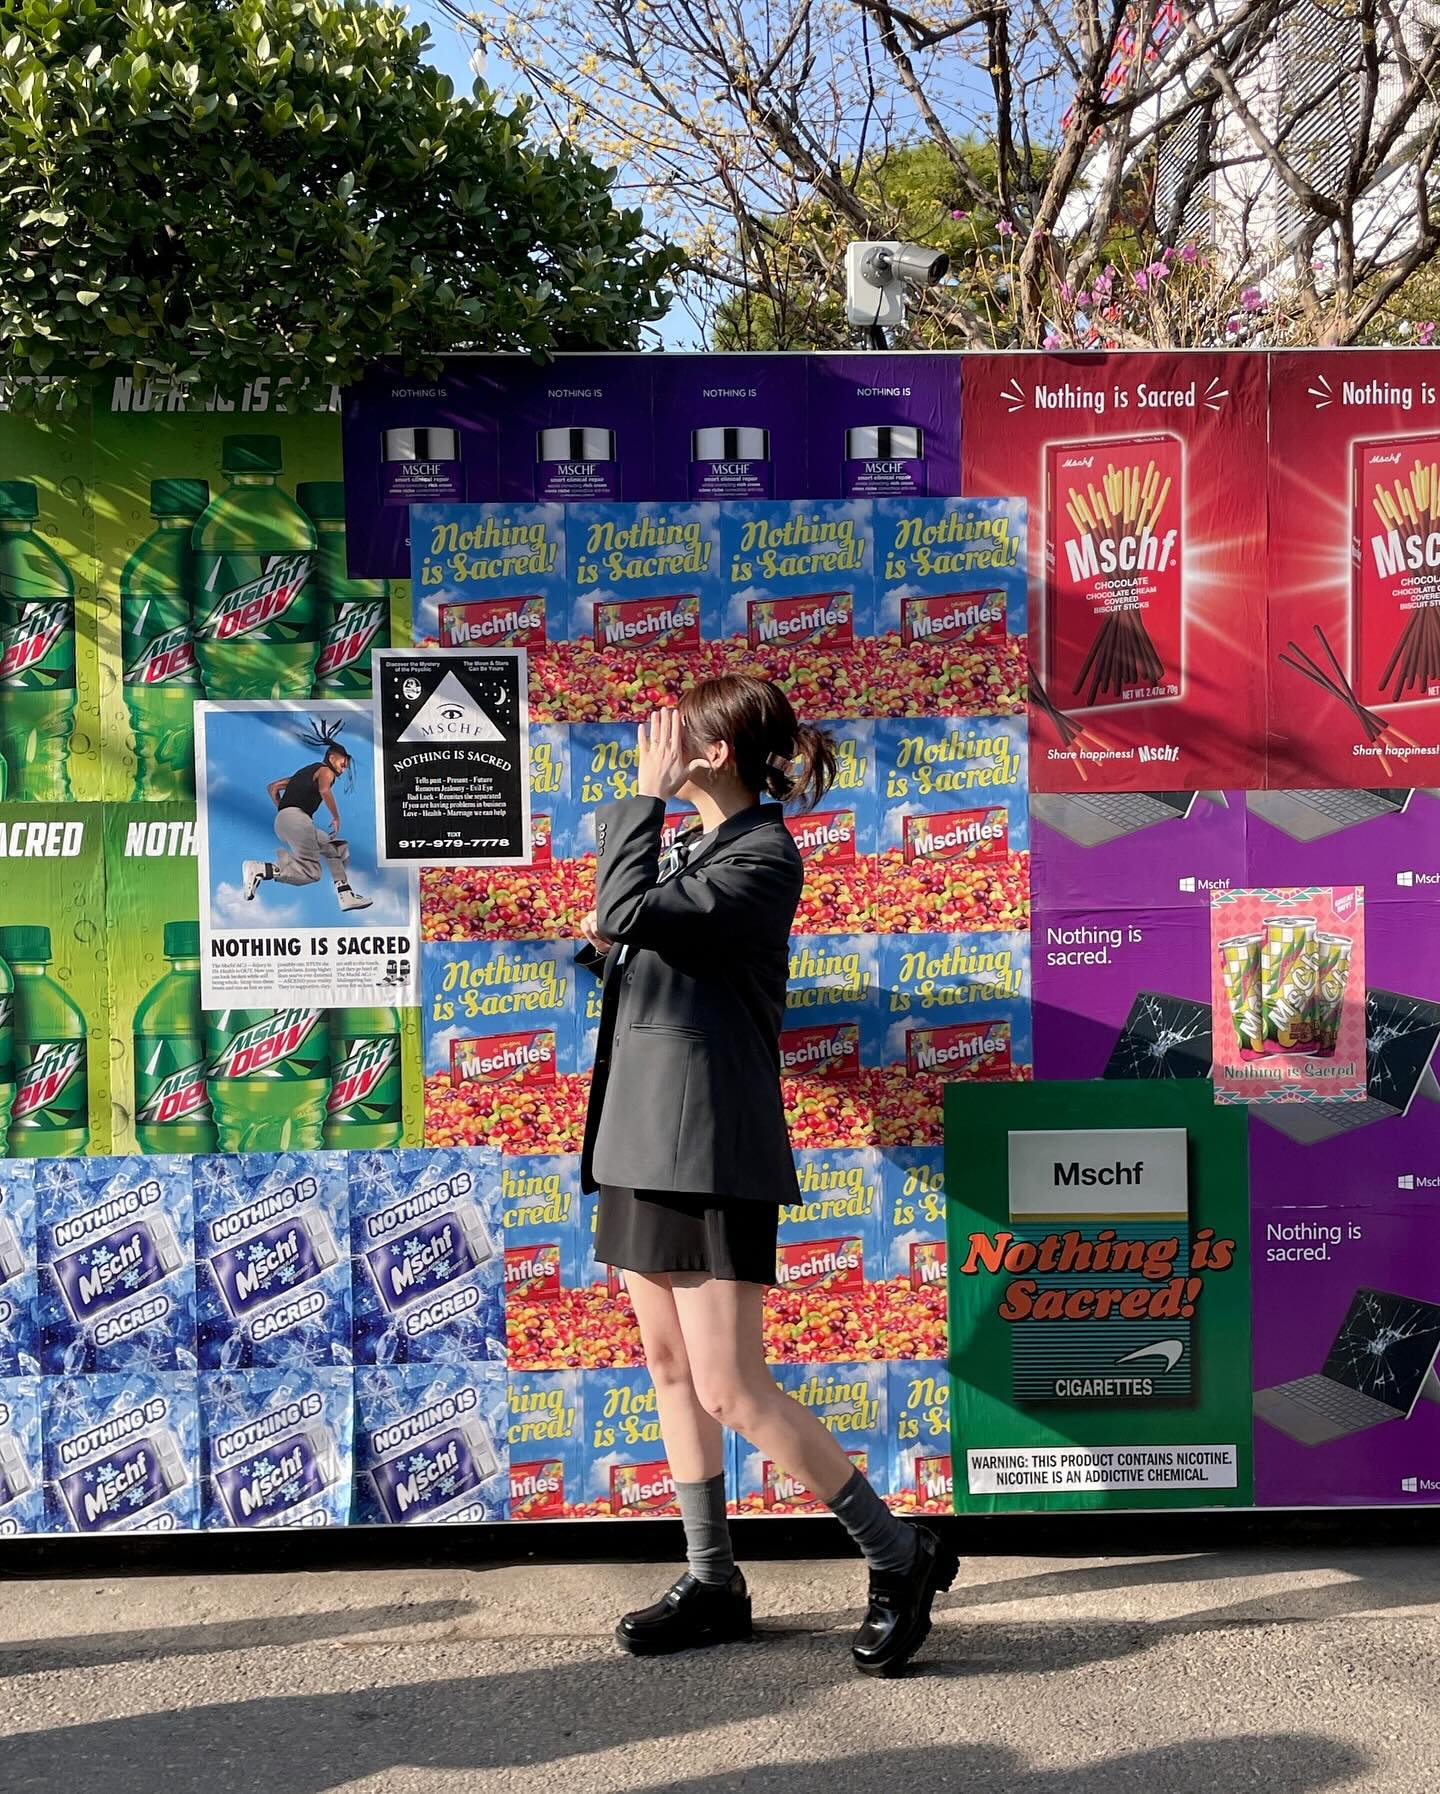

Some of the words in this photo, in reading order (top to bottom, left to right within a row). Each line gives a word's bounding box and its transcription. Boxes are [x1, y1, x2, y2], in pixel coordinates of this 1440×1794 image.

[548, 389, 591, 398] NOTHING
[593, 389, 602, 398] IS
[857, 388, 900, 397] NOTHING
[902, 387, 911, 397] IS
[1034, 383, 1105, 414] Nothing
[1113, 384, 1128, 409] is
[1136, 382, 1196, 409] Sacred
[1342, 380, 1413, 410] Nothing
[1421, 380, 1436, 405] is
[558, 465, 595, 475] MSCHF
[865, 463, 903, 473] MSCHF
[1062, 455, 1094, 468] Mschf
[432, 515, 545, 554] Nothing
[587, 514, 701, 554] Nothing
[741, 513, 854, 552] Nothing
[895, 512, 1009, 550] Nothing
[421, 557, 443, 585] is
[447, 543, 558, 582] Sacred!
[577, 556, 598, 584] is
[603, 541, 712, 581] Sacred!
[730, 554, 752, 582] is
[756, 539, 865, 579] Sacred!
[884, 552, 906, 581] is
[910, 536, 1019, 577] Sacred!
[1064, 526, 1178, 583] Mschf
[1086, 588, 1130, 600] CHOCOLATE
[1131, 586, 1157, 595] CREAM
[1094, 577, 1149, 591] CHOCOLATE
[1104, 595, 1139, 606] COVERED
[759, 607, 848, 642] Mschfles
[912, 605, 1002, 639] Mschfles
[1093, 603, 1122, 614] BISCUIT
[1123, 601, 1149, 610] STICKS
[450, 611, 542, 645] Mschfles
[605, 610, 696, 644] Mschfles
[421, 722, 483, 737] MSCHF
[393, 750, 451, 773] NOTHING
[454, 750, 465, 760] IS
[467, 750, 512, 772] SACRED
[896, 730, 1010, 768] Nothing
[1047, 748, 1077, 761] Share
[1079, 747, 1135, 762] happiness!
[1352, 745, 1382, 756] Share
[1385, 744, 1440, 757] happiness!
[441, 785, 465, 793] Jealousy
[482, 785, 493, 793] Eye
[886, 771, 908, 799] is
[911, 755, 1020, 795] Sacred!
[430, 802, 449, 810] having
[450, 801, 476, 810] problems
[474, 792, 502, 800] separated
[447, 810, 473, 818] Marriage
[493, 809, 507, 817] help
[124, 822, 199, 857] NOTH
[398, 839, 510, 848] 917-979-7778
[914, 822, 1004, 856] Mschfles
[1198, 877, 1230, 890] Mschf
[1415, 872, 1440, 884] Msch
[211, 937, 301, 957] NOTHING
[311, 937, 328, 956] IS
[337, 936, 411, 955] SACRED
[1047, 927, 1123, 948] Nothing
[1128, 926, 1142, 943] is
[441, 954, 556, 992] Nothing
[788, 947, 860, 981] thing
[899, 945, 1011, 983] Nothing
[1047, 947, 1112, 966] sacred.
[432, 994, 455, 1021] is
[458, 977, 568, 1018] Sacred!
[889, 984, 911, 1013] is
[914, 970, 1022, 1009] Sacred!
[461, 1046, 551, 1079] Mschfles
[917, 1036, 1007, 1070] Mschfles
[1224, 1065, 1282, 1080] Nothing
[1287, 1066, 1300, 1079] is
[1304, 1063, 1355, 1079] Sacred
[1054, 1161, 1144, 1186] Mschf
[55, 1192, 141, 1246] NOTHING
[139, 1181, 162, 1207] IS
[212, 1186, 297, 1242] NOTHING
[295, 1177, 317, 1203] IS
[368, 1182, 451, 1237] NOTHING
[449, 1172, 472, 1198] IS
[1266, 1222, 1342, 1245] Nothing
[1348, 1222, 1362, 1239] is
[78, 1234, 141, 1304] Mschf
[236, 1230, 298, 1300] Mschf
[391, 1225, 453, 1296] Mschf
[960, 1230, 1178, 1279] Nothing
[1190, 1228, 1236, 1271] is
[1266, 1244, 1331, 1261] sacred.
[251, 1291, 325, 1341] SACRED
[406, 1286, 479, 1336] SACRED
[998, 1277, 1203, 1321] Sacred!
[95, 1296, 169, 1346] SACRED
[1055, 1378, 1153, 1397] CIGARETTES
[60, 1408, 146, 1464] NOTHING
[144, 1398, 167, 1423] IS
[373, 1397, 456, 1454] NOTHING
[454, 1387, 477, 1414] IS
[395, 1441, 459, 1512] Mschf
[971, 1455, 1029, 1470] WARNING:
[1032, 1454, 1057, 1469] THIS
[1060, 1453, 1114, 1468] PRODUCT
[1117, 1452, 1173, 1466] CONTAINS
[1176, 1451, 1232, 1465] NICOTINE.
[996, 1470, 1049, 1485] NICOTINE
[1052, 1470, 1062, 1484] IS
[1066, 1469, 1081, 1483] AN
[1084, 1468, 1145, 1483] ADDICTIVE
[1147, 1468, 1209, 1482] CHEMICAL.
[84, 1451, 147, 1522] Mschf
